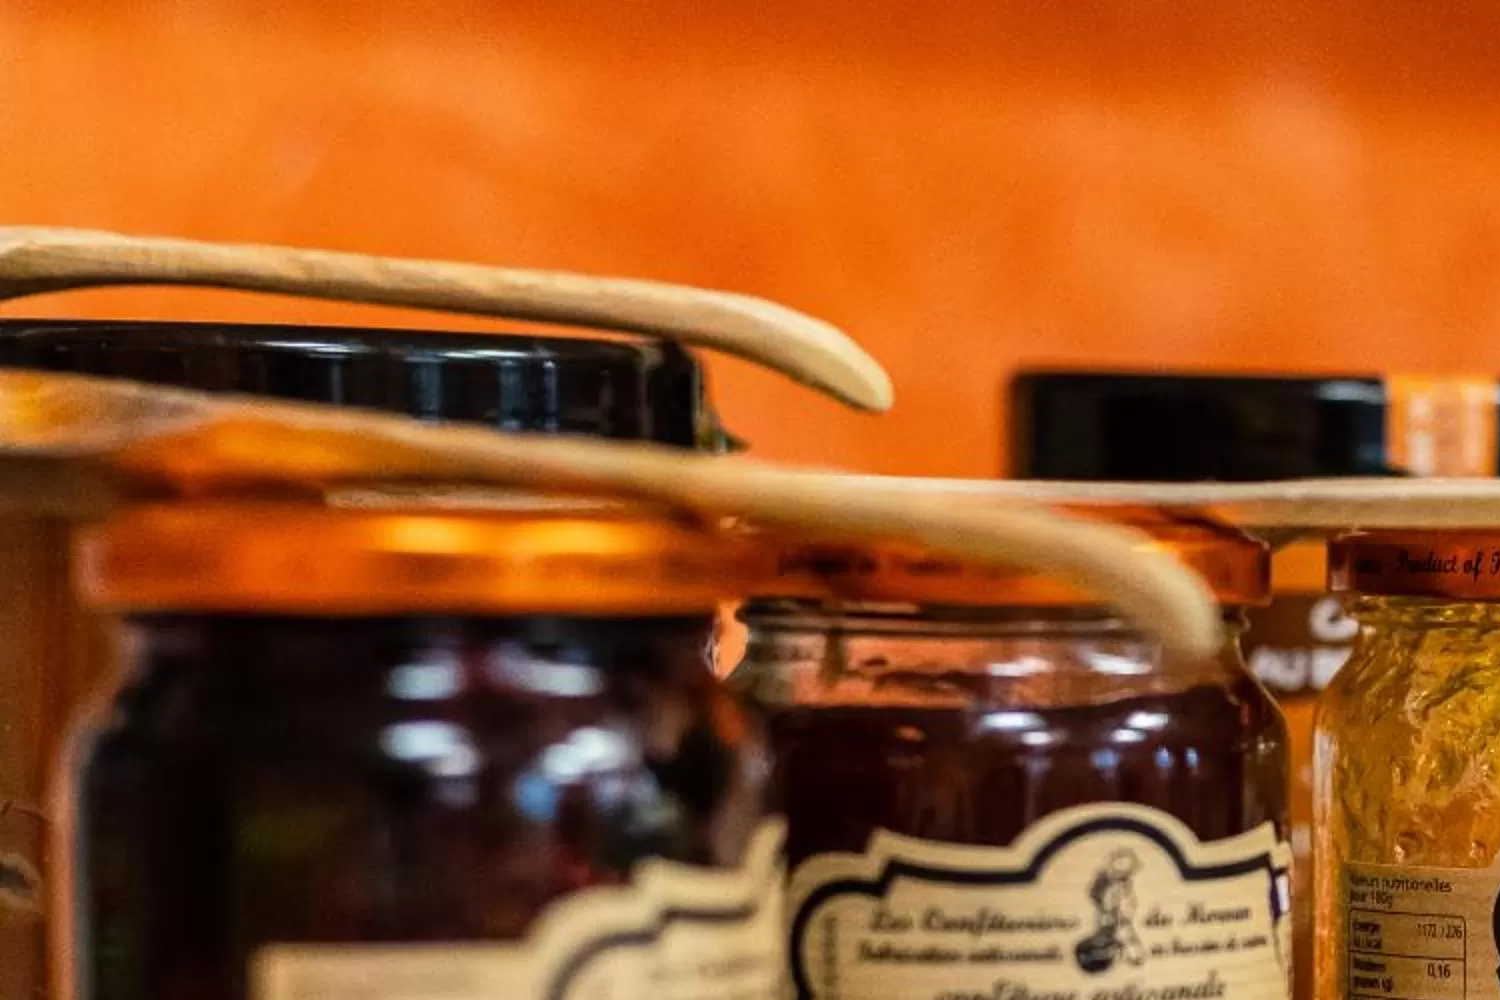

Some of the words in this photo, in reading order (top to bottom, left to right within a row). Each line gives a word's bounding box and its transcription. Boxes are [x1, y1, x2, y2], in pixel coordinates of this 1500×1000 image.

[1396, 551, 1459, 575] Product
[1463, 551, 1481, 581] of
[1427, 963, 1451, 979] 0,16
